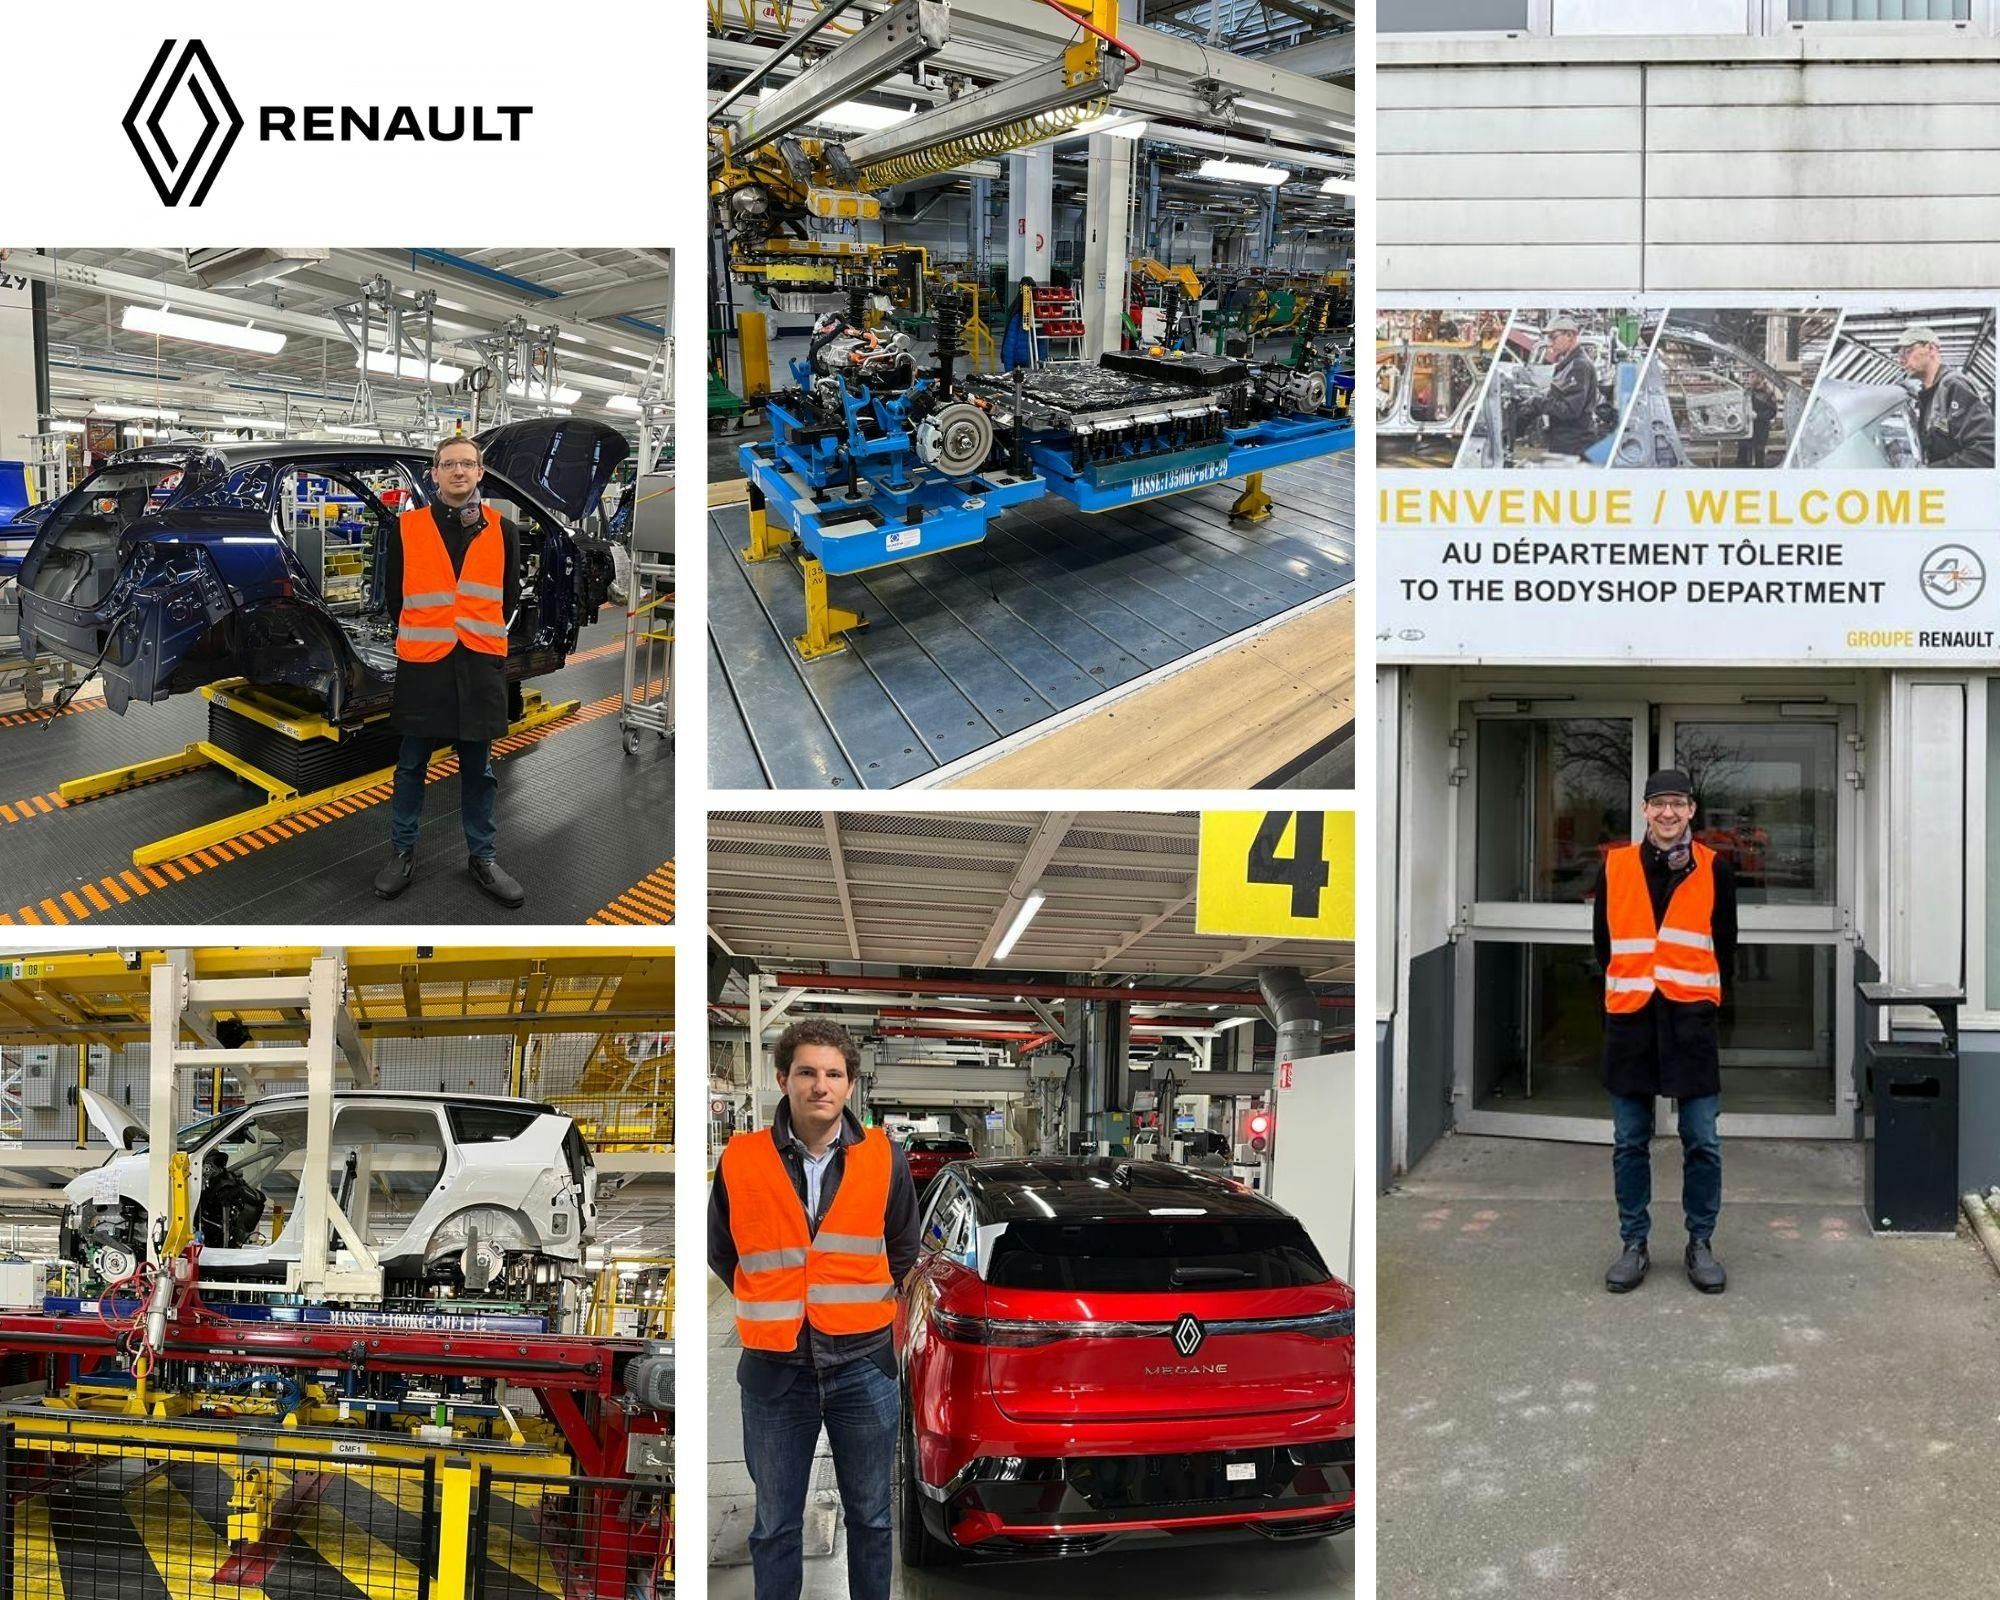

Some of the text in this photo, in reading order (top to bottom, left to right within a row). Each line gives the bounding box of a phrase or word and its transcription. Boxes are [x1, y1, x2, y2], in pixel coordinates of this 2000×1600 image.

[1379, 489, 1946, 525] IENVENUE / WELCOME
[1442, 537, 1843, 566] AU DÉPARTEMENT TÔLERIE
[1400, 579, 1886, 604] TO THE BODYSHOP DEPARTMENT
[1846, 631, 1994, 648] GROUPE RENAULT
[1247, 811, 1329, 919] 4
[1145, 1364, 1228, 1375] MEGANE
[338, 1444, 361, 1453] CMF1
